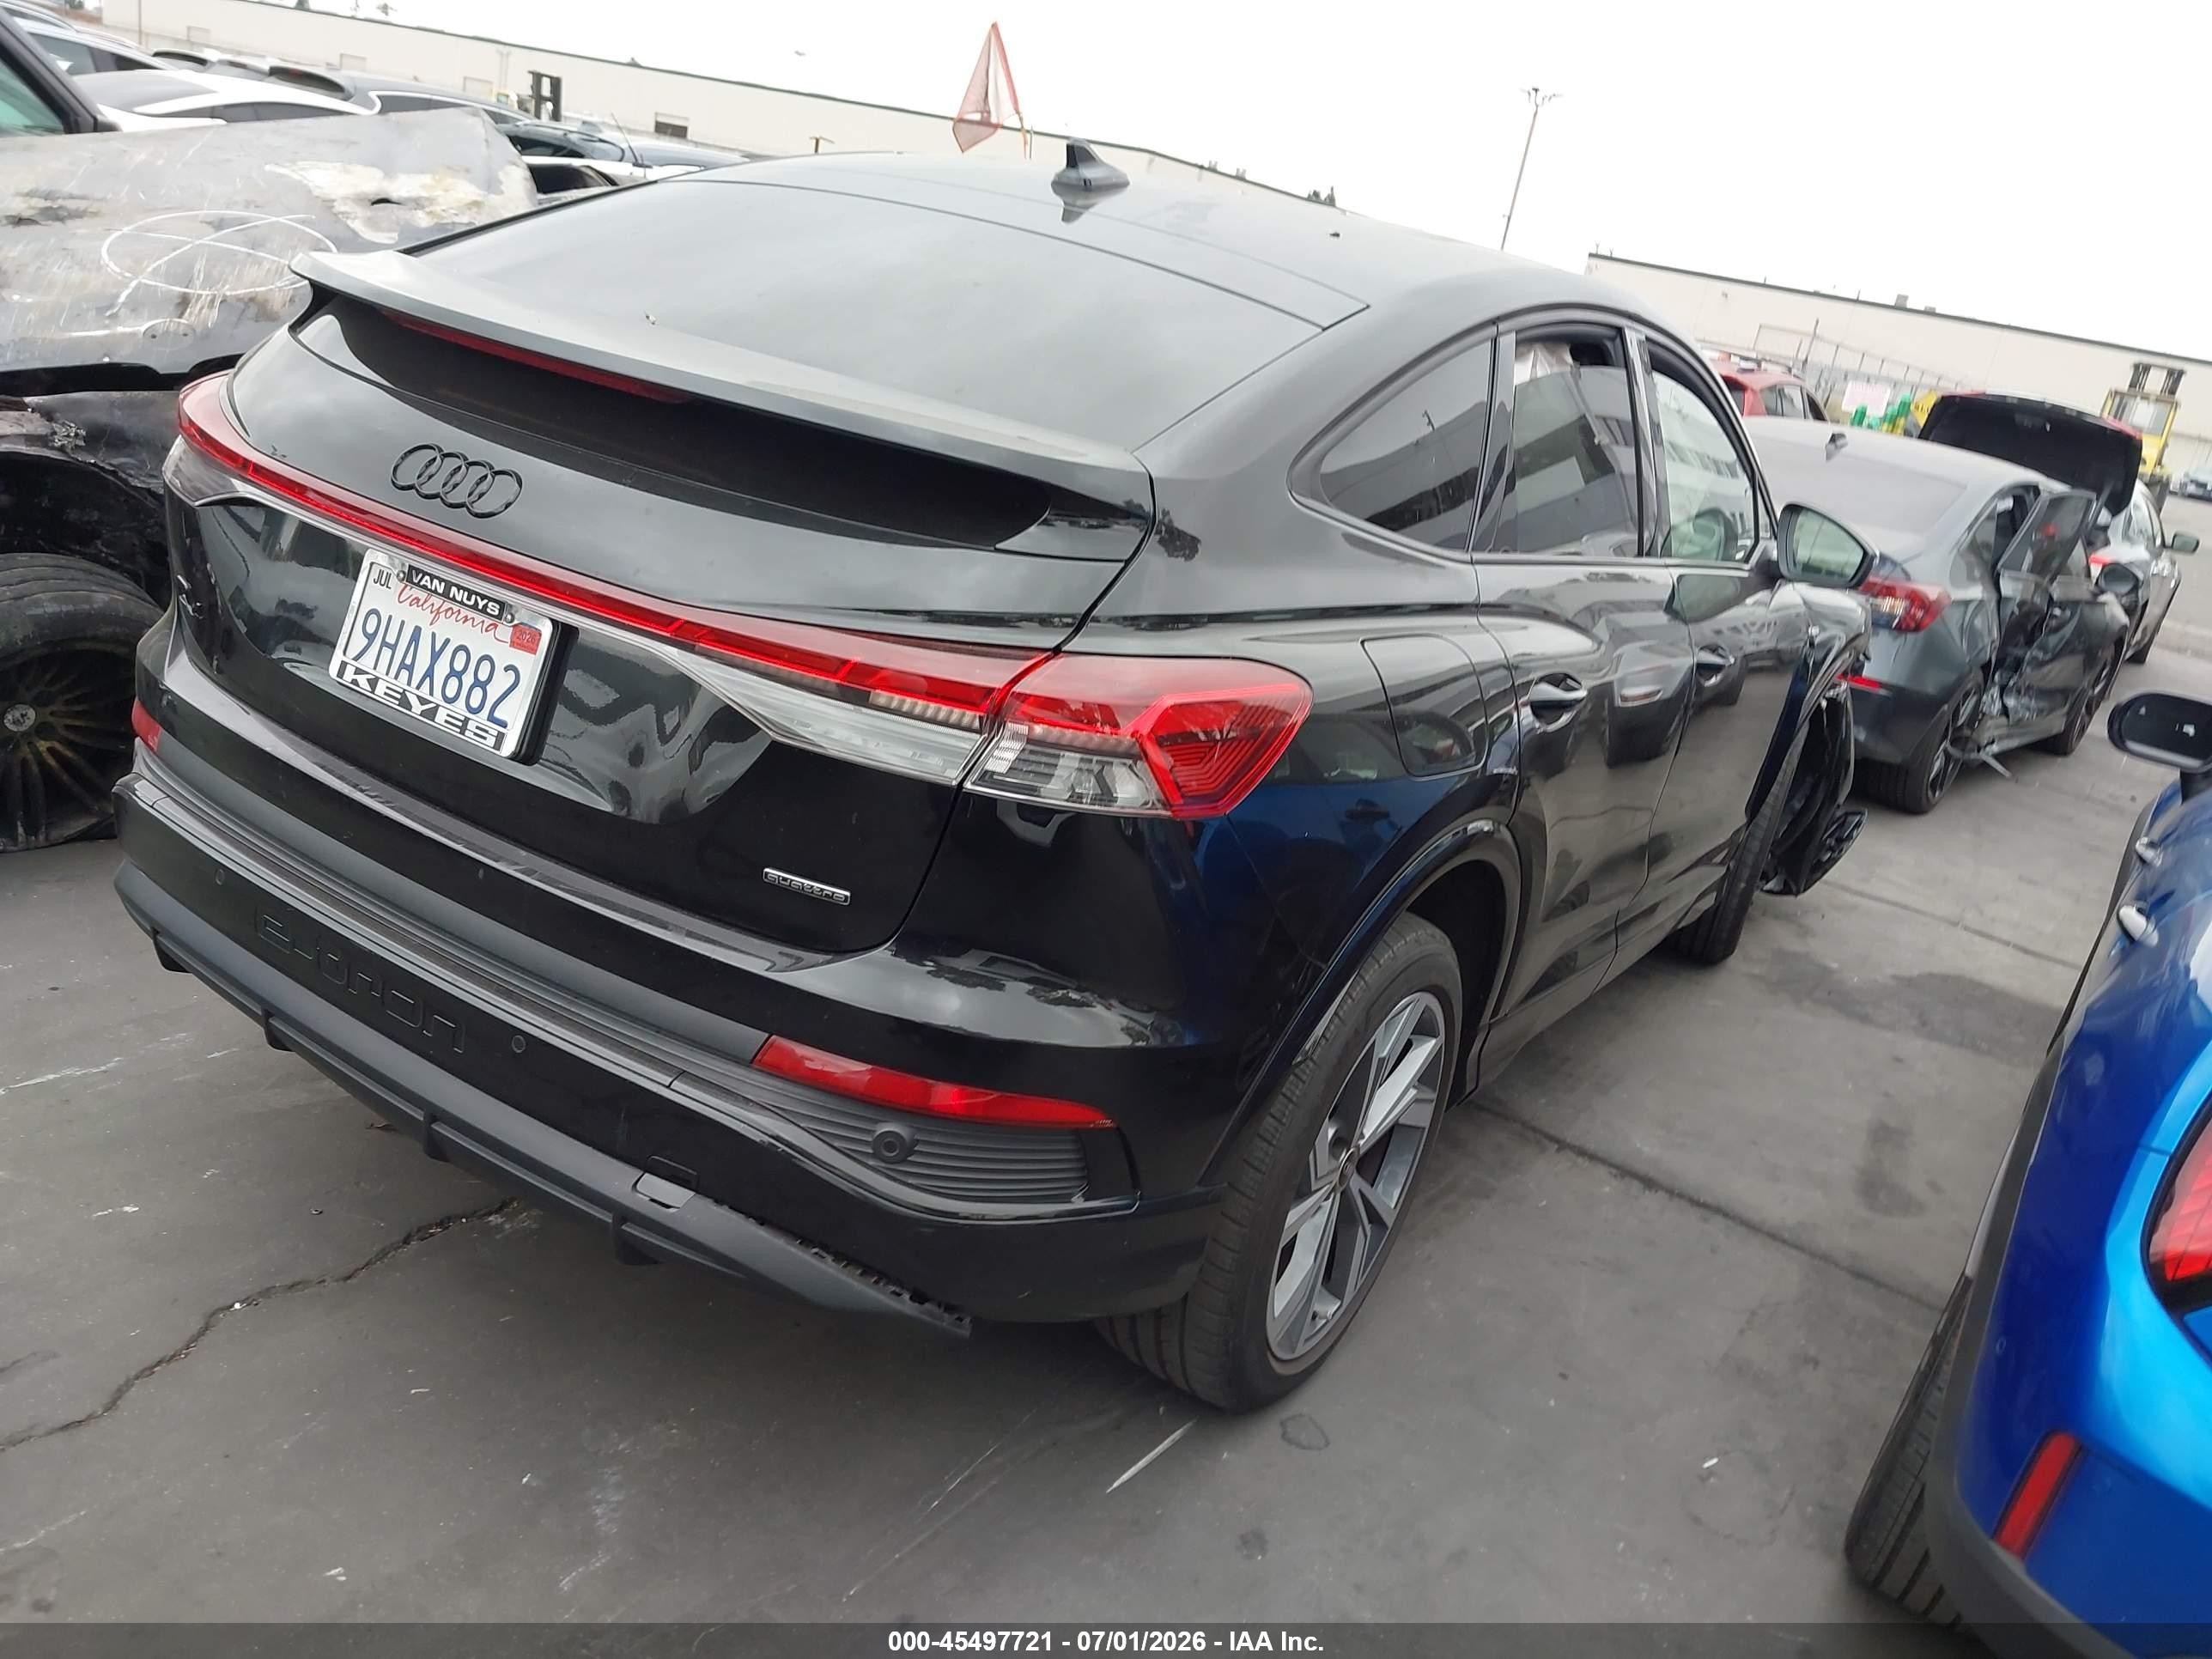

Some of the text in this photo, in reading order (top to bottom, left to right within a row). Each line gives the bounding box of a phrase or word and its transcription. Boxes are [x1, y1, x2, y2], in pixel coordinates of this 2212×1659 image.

[373, 568, 392, 590] JUL
[411, 569, 501, 616] VAN NUYS
[398, 582, 509, 643] California
[516, 629, 537, 644] 2026
[351, 607, 521, 728] 9HAX882
[342, 662, 500, 748] KEYES
[767, 872, 846, 902] quattro
